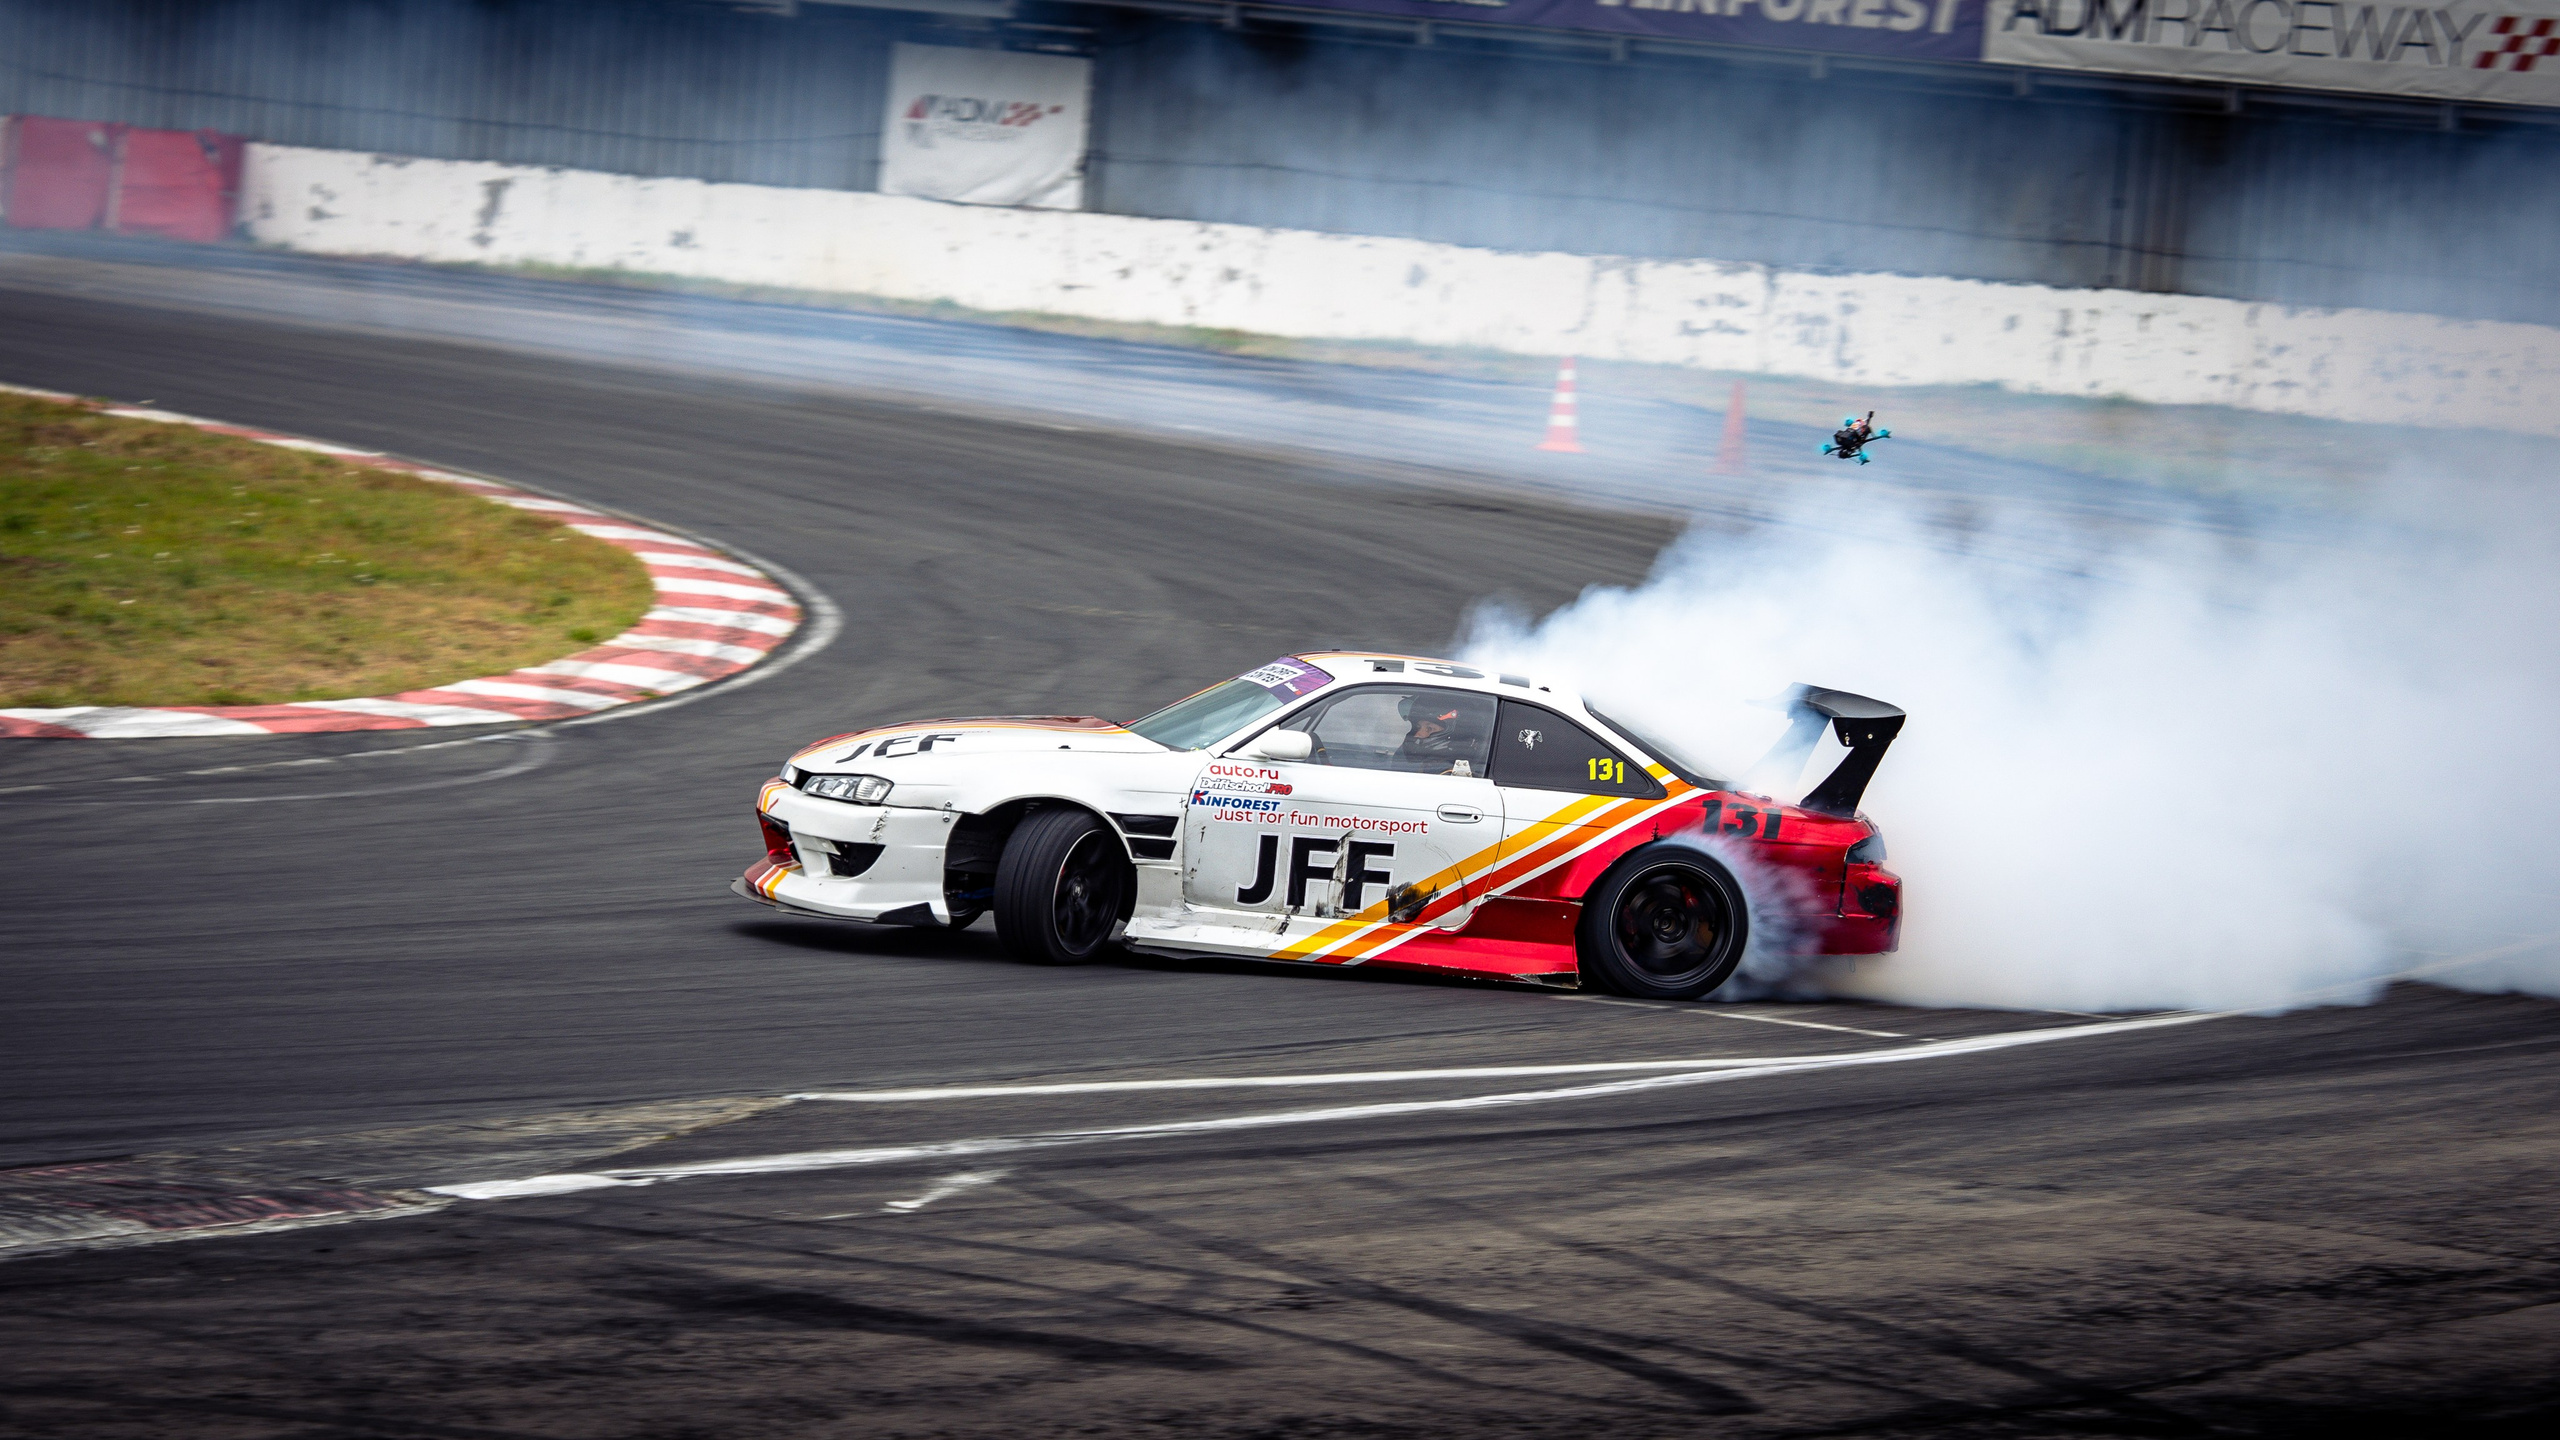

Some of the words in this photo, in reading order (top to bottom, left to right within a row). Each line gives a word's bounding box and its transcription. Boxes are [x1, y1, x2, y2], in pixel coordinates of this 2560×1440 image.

[1364, 659, 1531, 688] 131
[1209, 764, 1279, 780] auto.ru
[1588, 758, 1624, 784] 131
[1191, 790, 1281, 812] KINFOREST
[1214, 808, 1253, 823] Just
[1290, 810, 1319, 826] fun
[1324, 815, 1429, 836] motorsport
[1701, 800, 1784, 840] 131
[1236, 834, 1395, 910] JFF
